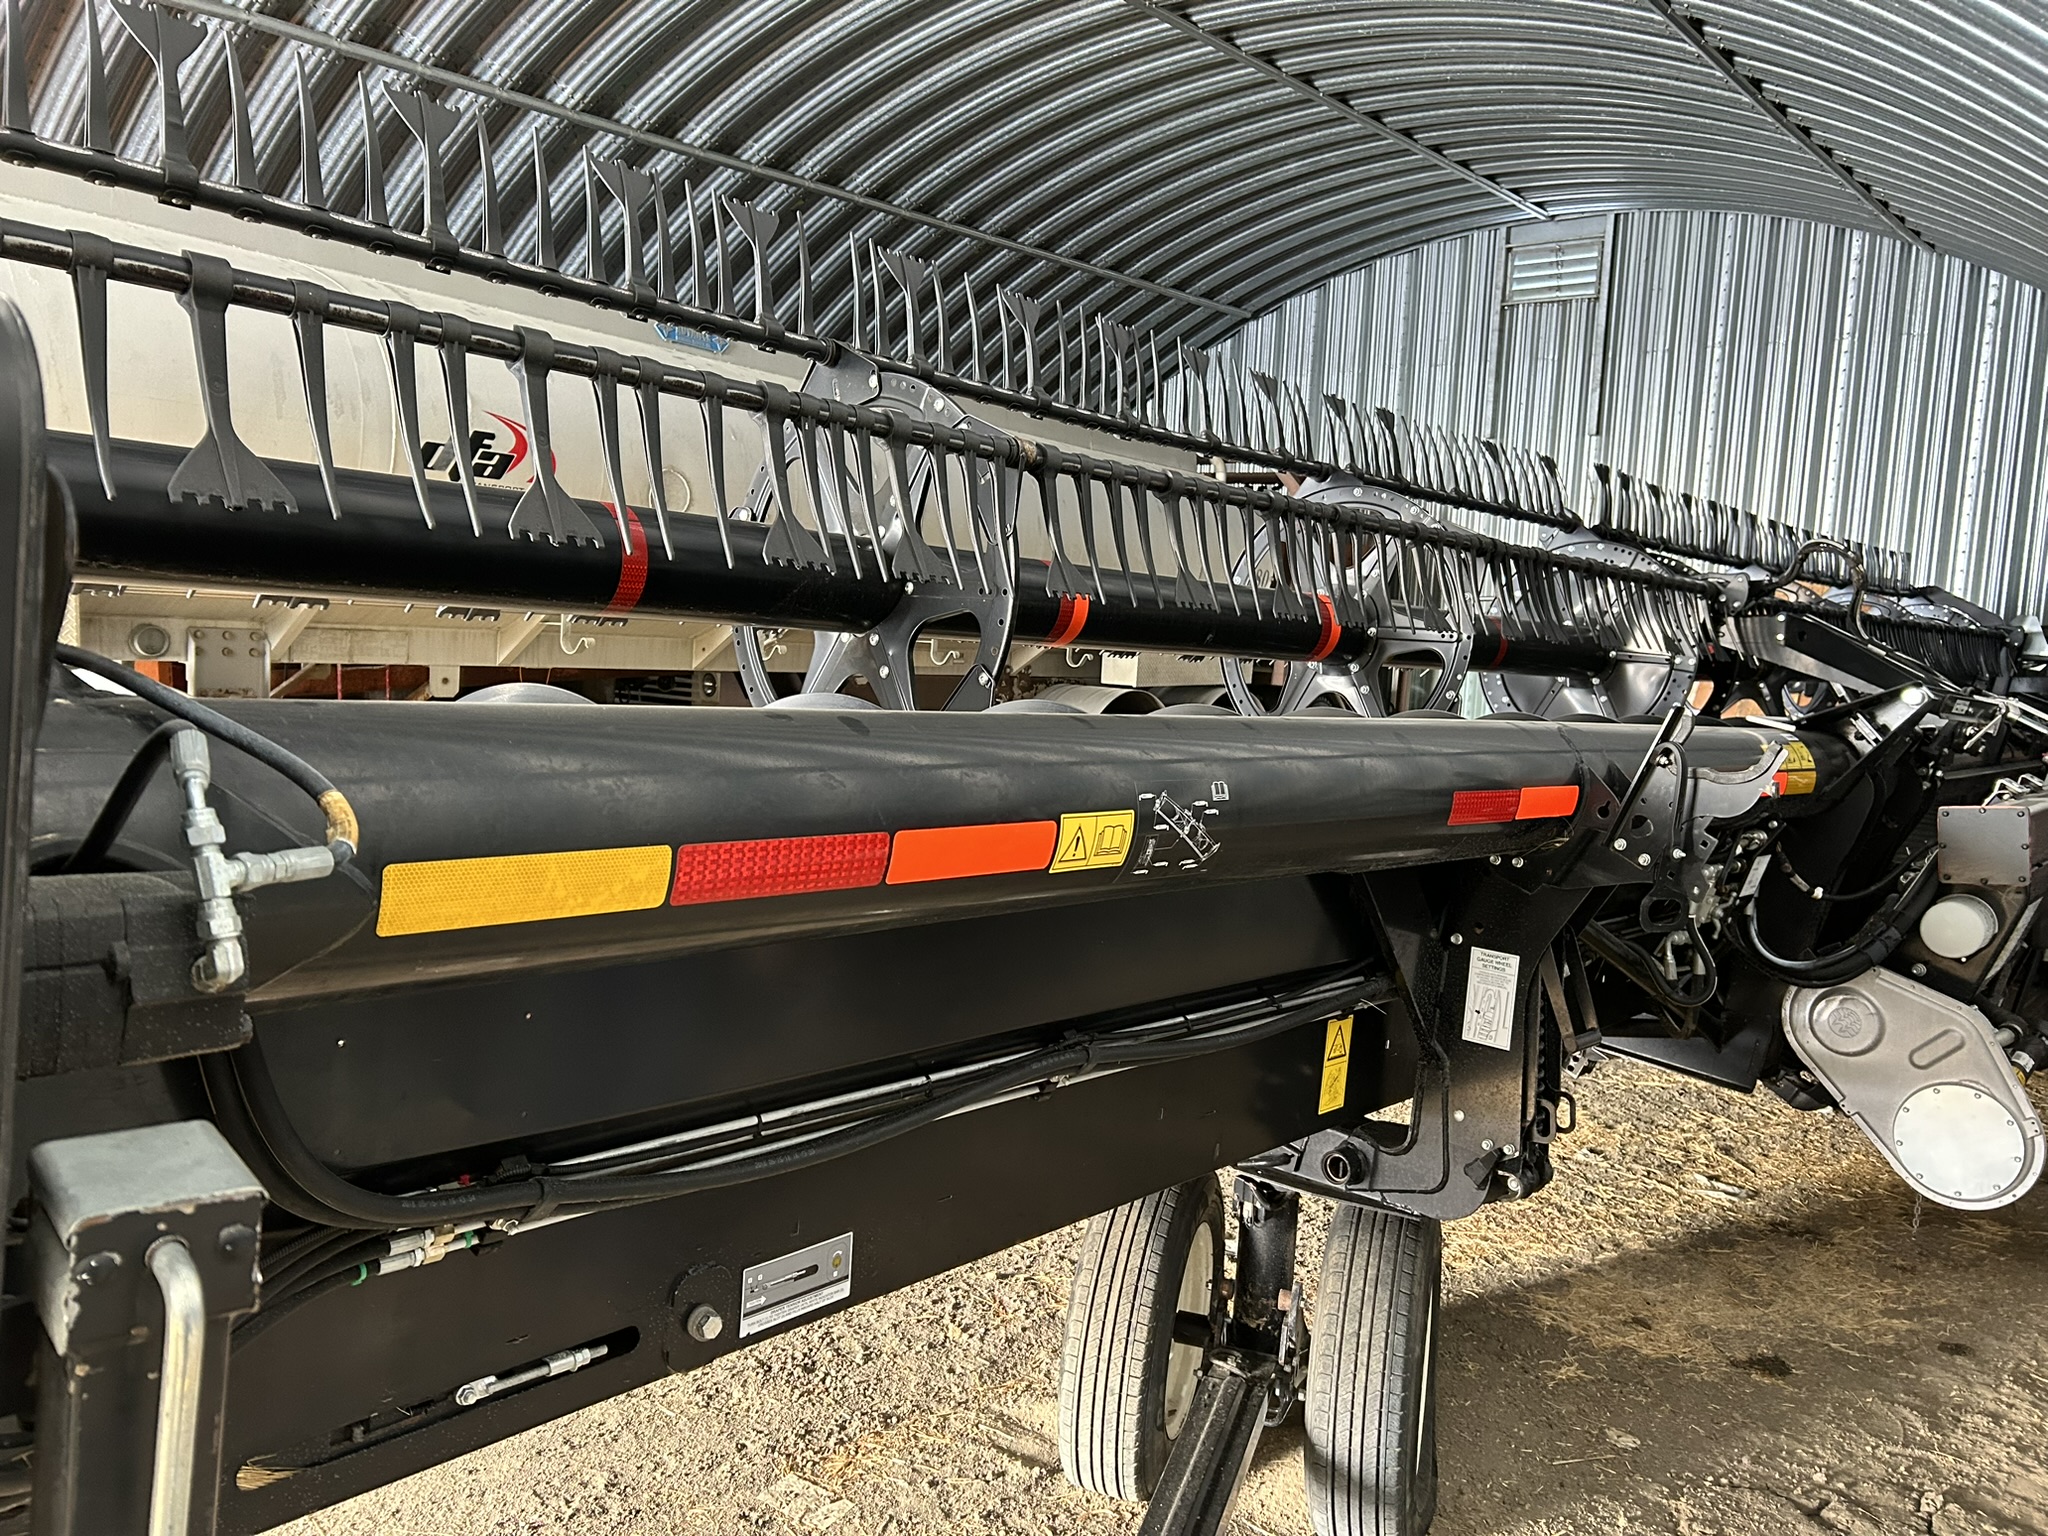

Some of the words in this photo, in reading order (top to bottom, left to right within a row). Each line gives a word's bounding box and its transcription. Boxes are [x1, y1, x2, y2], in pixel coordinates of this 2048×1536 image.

[1480, 951, 1510, 961] TRANSPORT
[1476, 956, 1494, 965] GAUGE
[1494, 959, 1512, 969] WHEEL
[1482, 963, 1506, 972] SETTINGS
